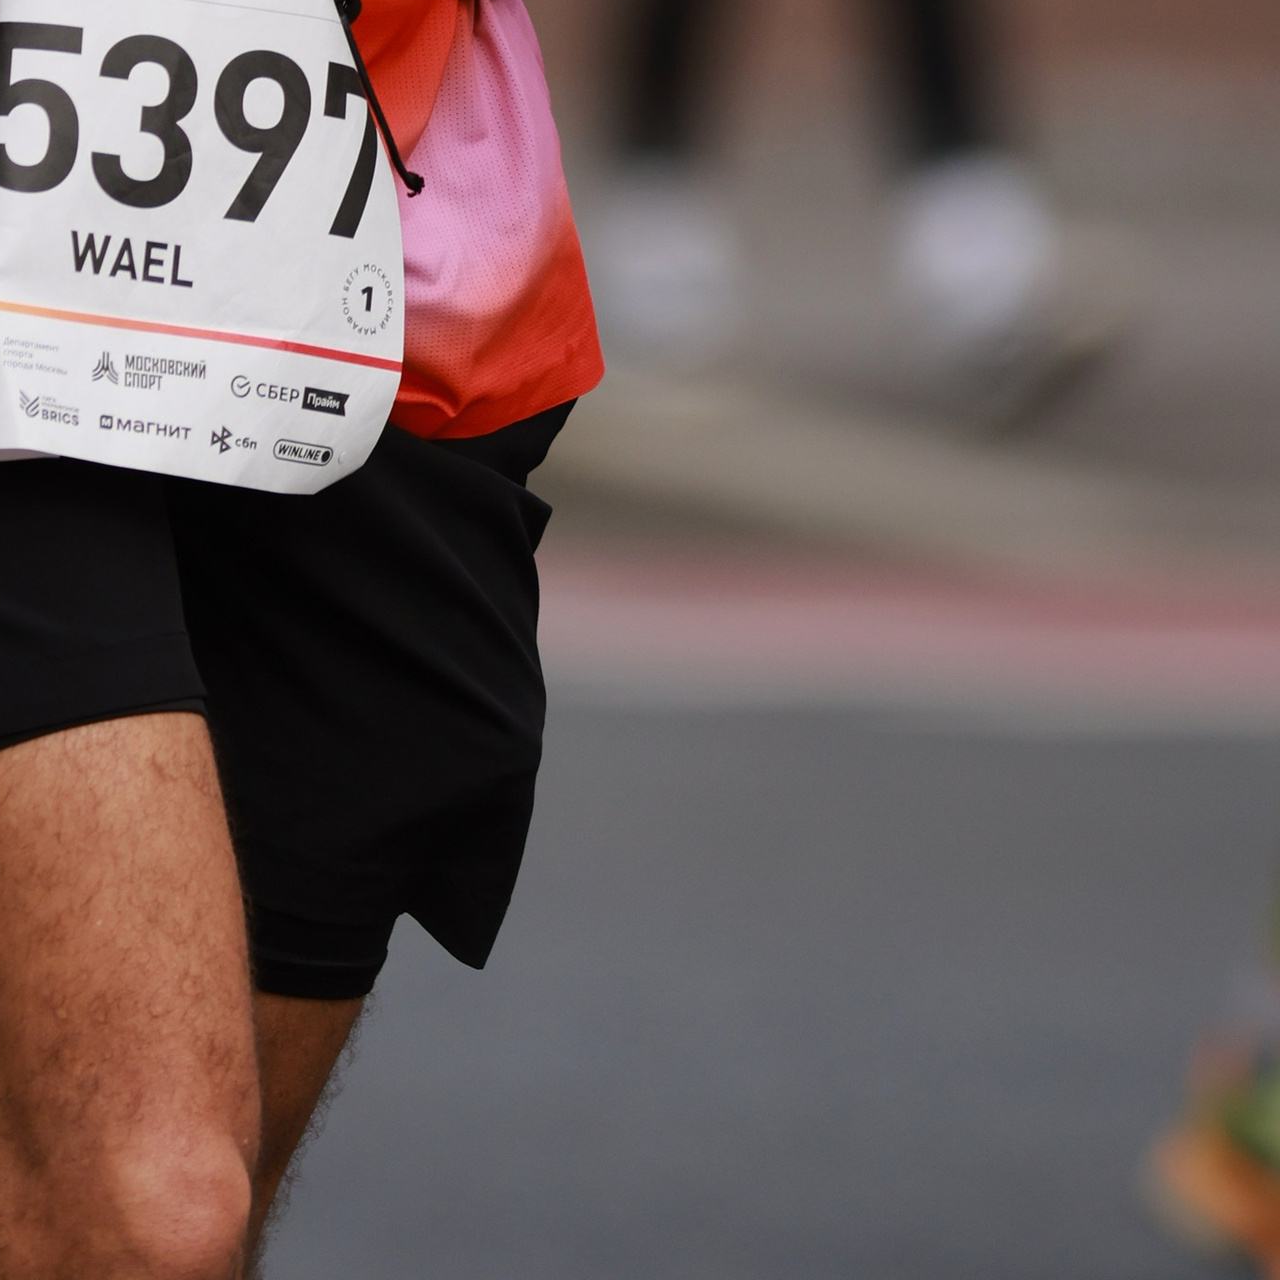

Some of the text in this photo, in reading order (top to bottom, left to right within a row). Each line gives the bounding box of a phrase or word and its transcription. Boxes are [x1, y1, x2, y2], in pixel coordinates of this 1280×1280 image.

[70, 229, 194, 288] WAEL
[361, 286, 373, 312] 1
[3, 337, 59, 352] Департамент
[3, 348, 33, 360] спорта
[3, 359, 68, 376] города Москвы
[124, 354, 207, 380] МОСКОВСКИЙ
[124, 373, 163, 391] СПОРТ
[256, 382, 340, 410] СБЕР Прайм
[41, 408, 80, 427] BRICS
[235, 436, 258, 450] сбп
[276, 442, 322, 462] WINLINE
